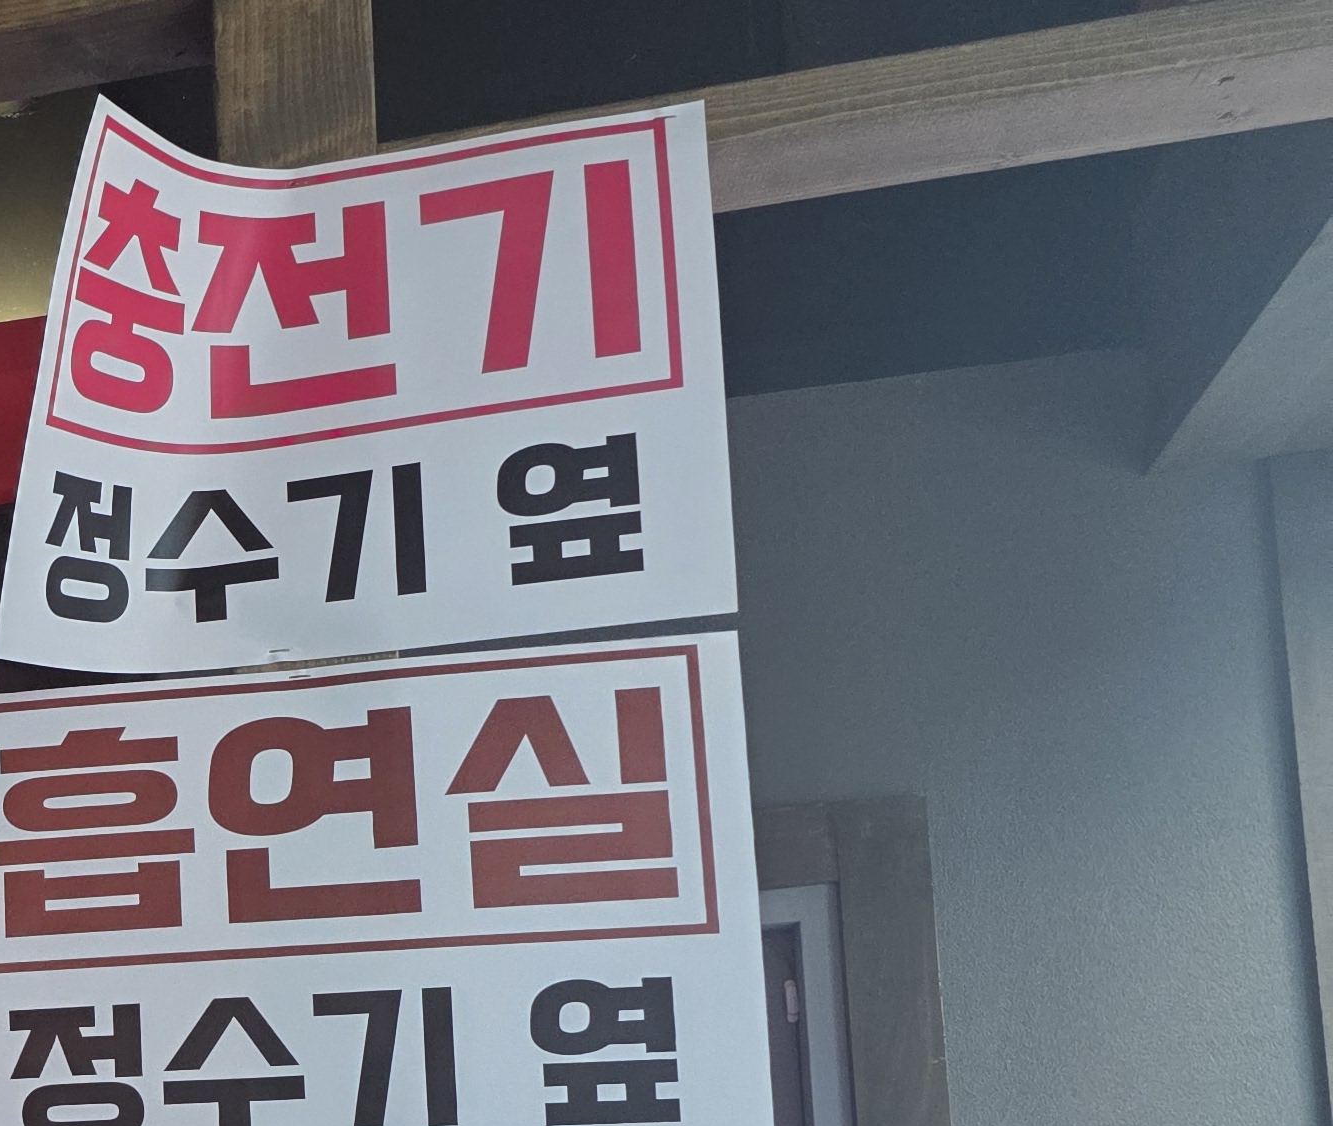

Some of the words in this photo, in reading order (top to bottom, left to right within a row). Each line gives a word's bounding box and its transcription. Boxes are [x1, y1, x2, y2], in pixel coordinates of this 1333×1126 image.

[69, 159, 642, 419] 충전기
[44, 462, 429, 623] 정수기
[495, 432, 645, 586] 옆
[532, 976, 682, 1126] 옆
